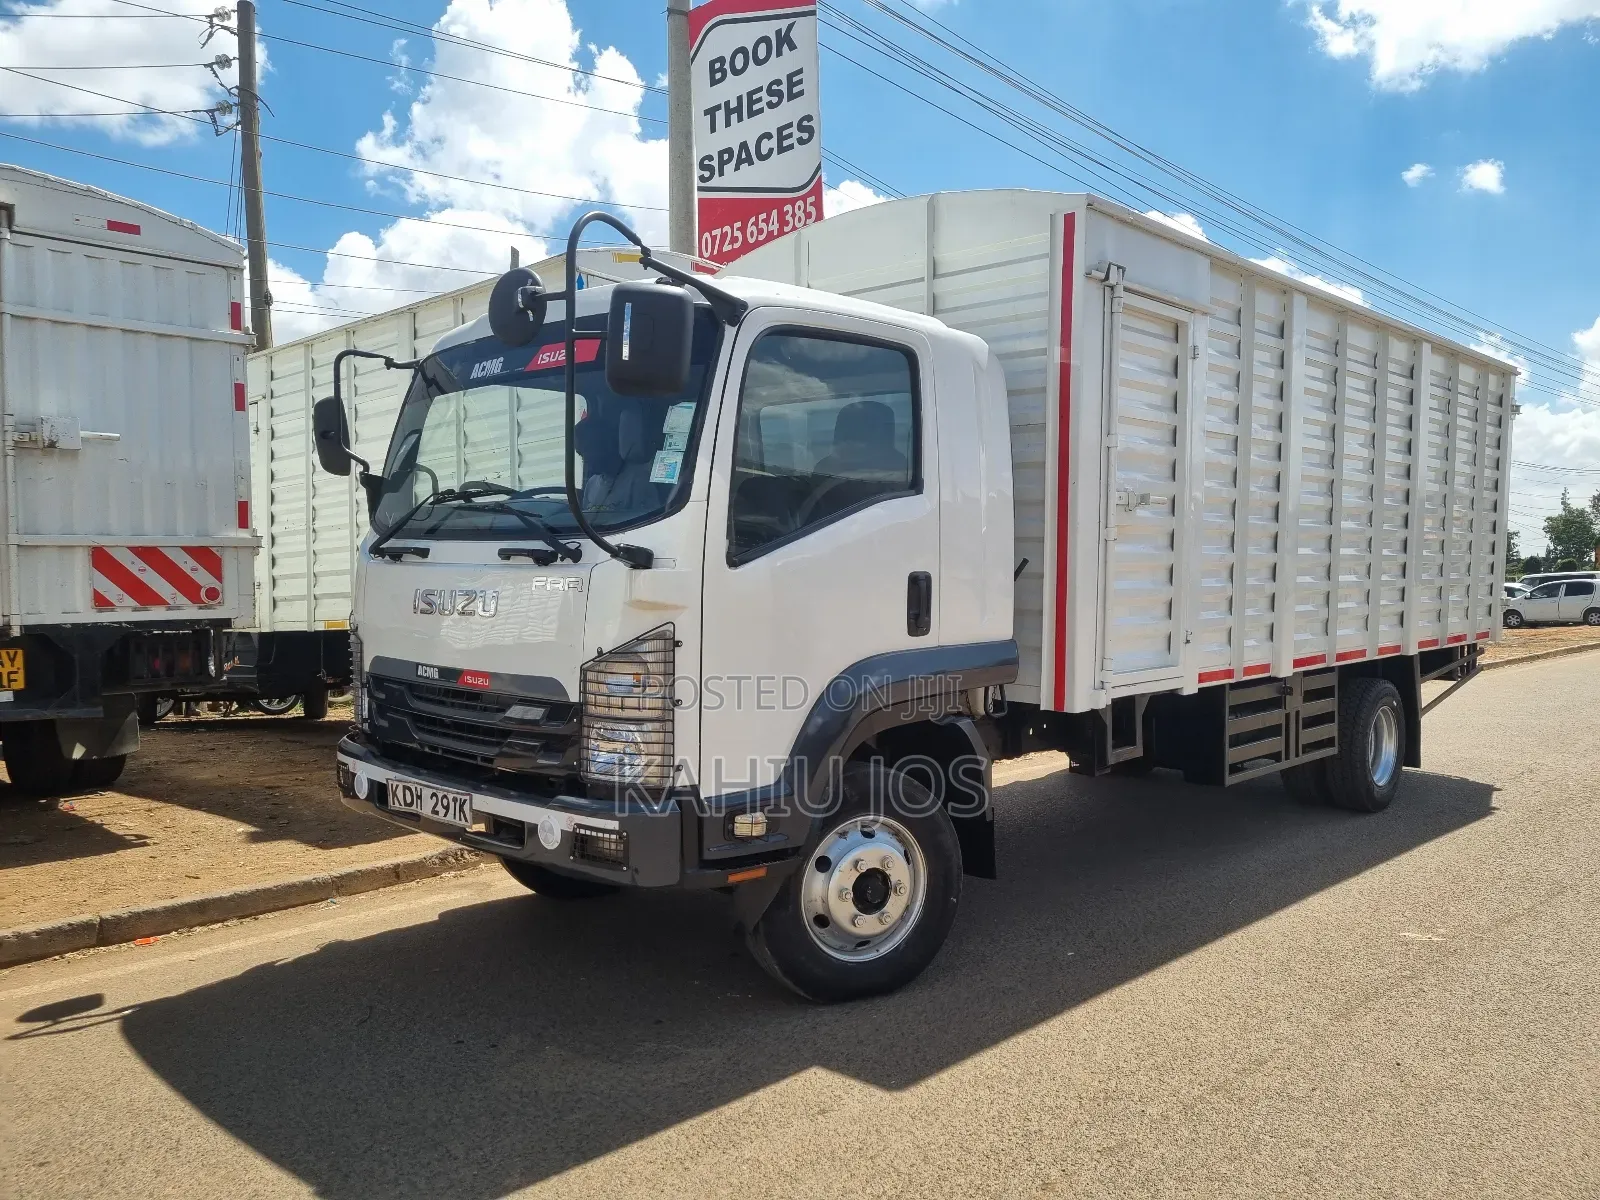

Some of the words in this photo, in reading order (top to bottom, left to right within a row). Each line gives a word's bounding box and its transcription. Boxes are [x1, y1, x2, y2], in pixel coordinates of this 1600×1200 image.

[708, 20, 798, 88] BOOK
[703, 67, 805, 135] THESE
[697, 113, 816, 184] SPACES
[701, 221, 743, 259] 0725
[746, 208, 780, 245] 654
[783, 195, 817, 233] 385
[537, 346, 577, 365] ISUZ
[412, 588, 500, 619] ISUZU
[417, 664, 440, 680] ACMG
[464, 675, 490, 686] ISUZU
[390, 783, 423, 811] KDH
